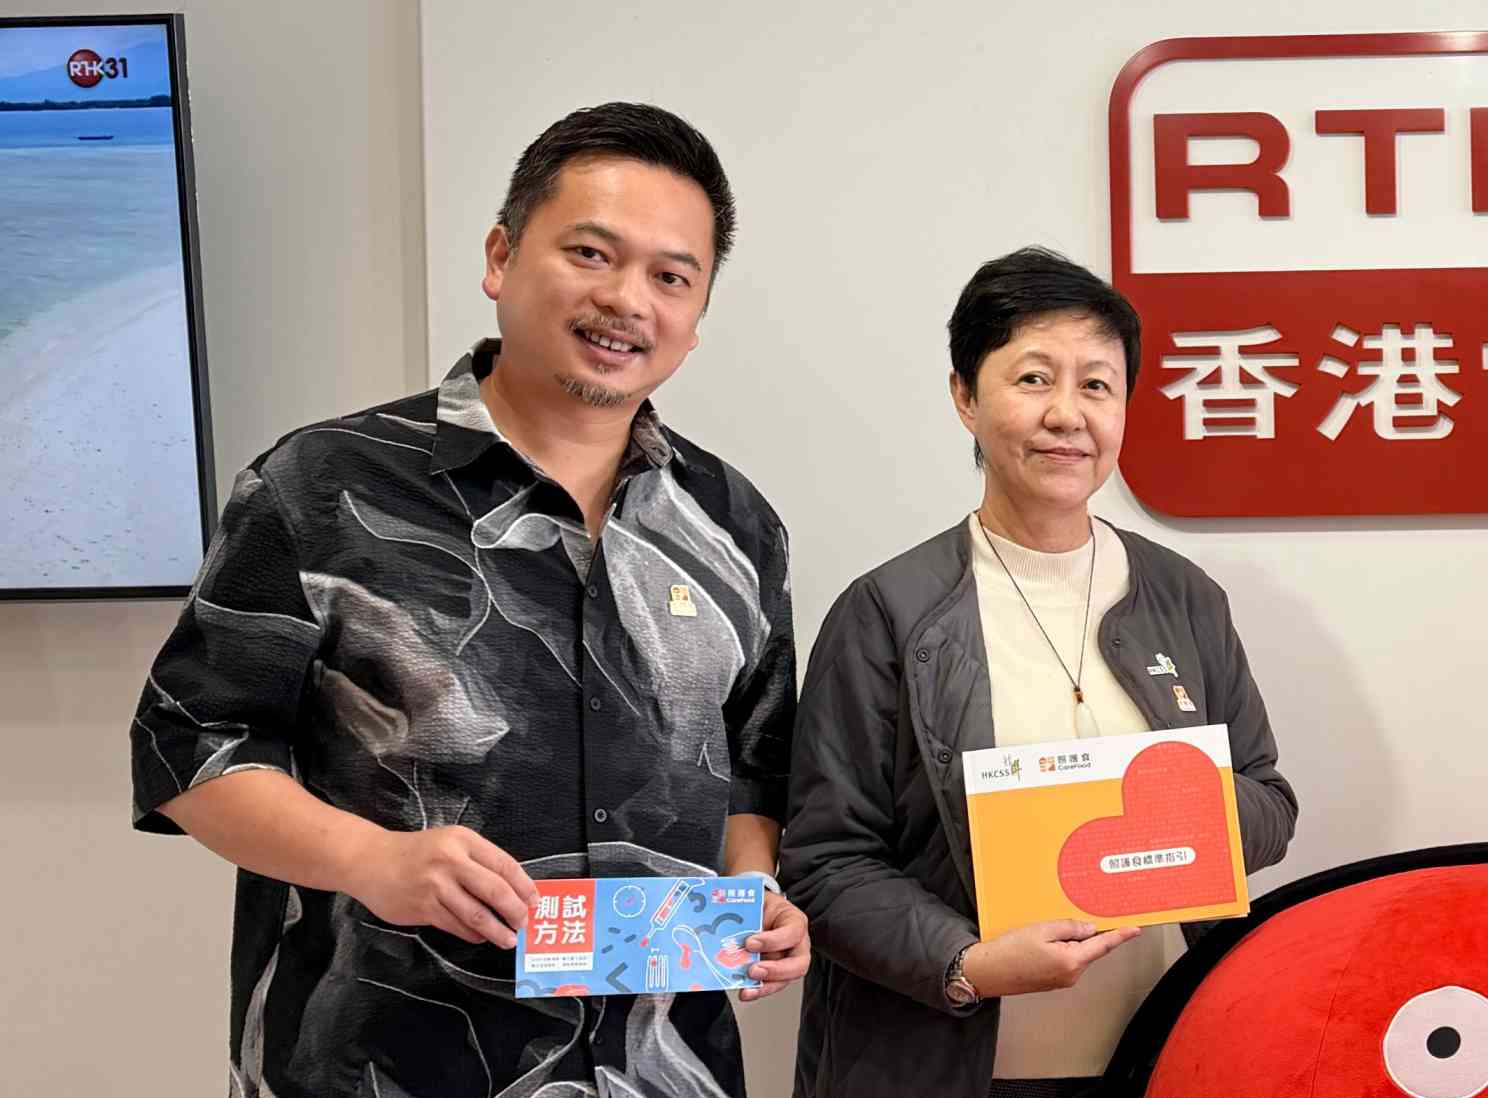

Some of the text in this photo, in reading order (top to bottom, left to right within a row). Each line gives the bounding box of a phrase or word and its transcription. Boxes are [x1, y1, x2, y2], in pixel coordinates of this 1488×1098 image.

[981, 769, 1010, 780] HKCSS
[1108, 851, 1189, 870] 照護食標準指引
[534, 895, 587, 919] 測試
[533, 920, 587, 945] 方法
